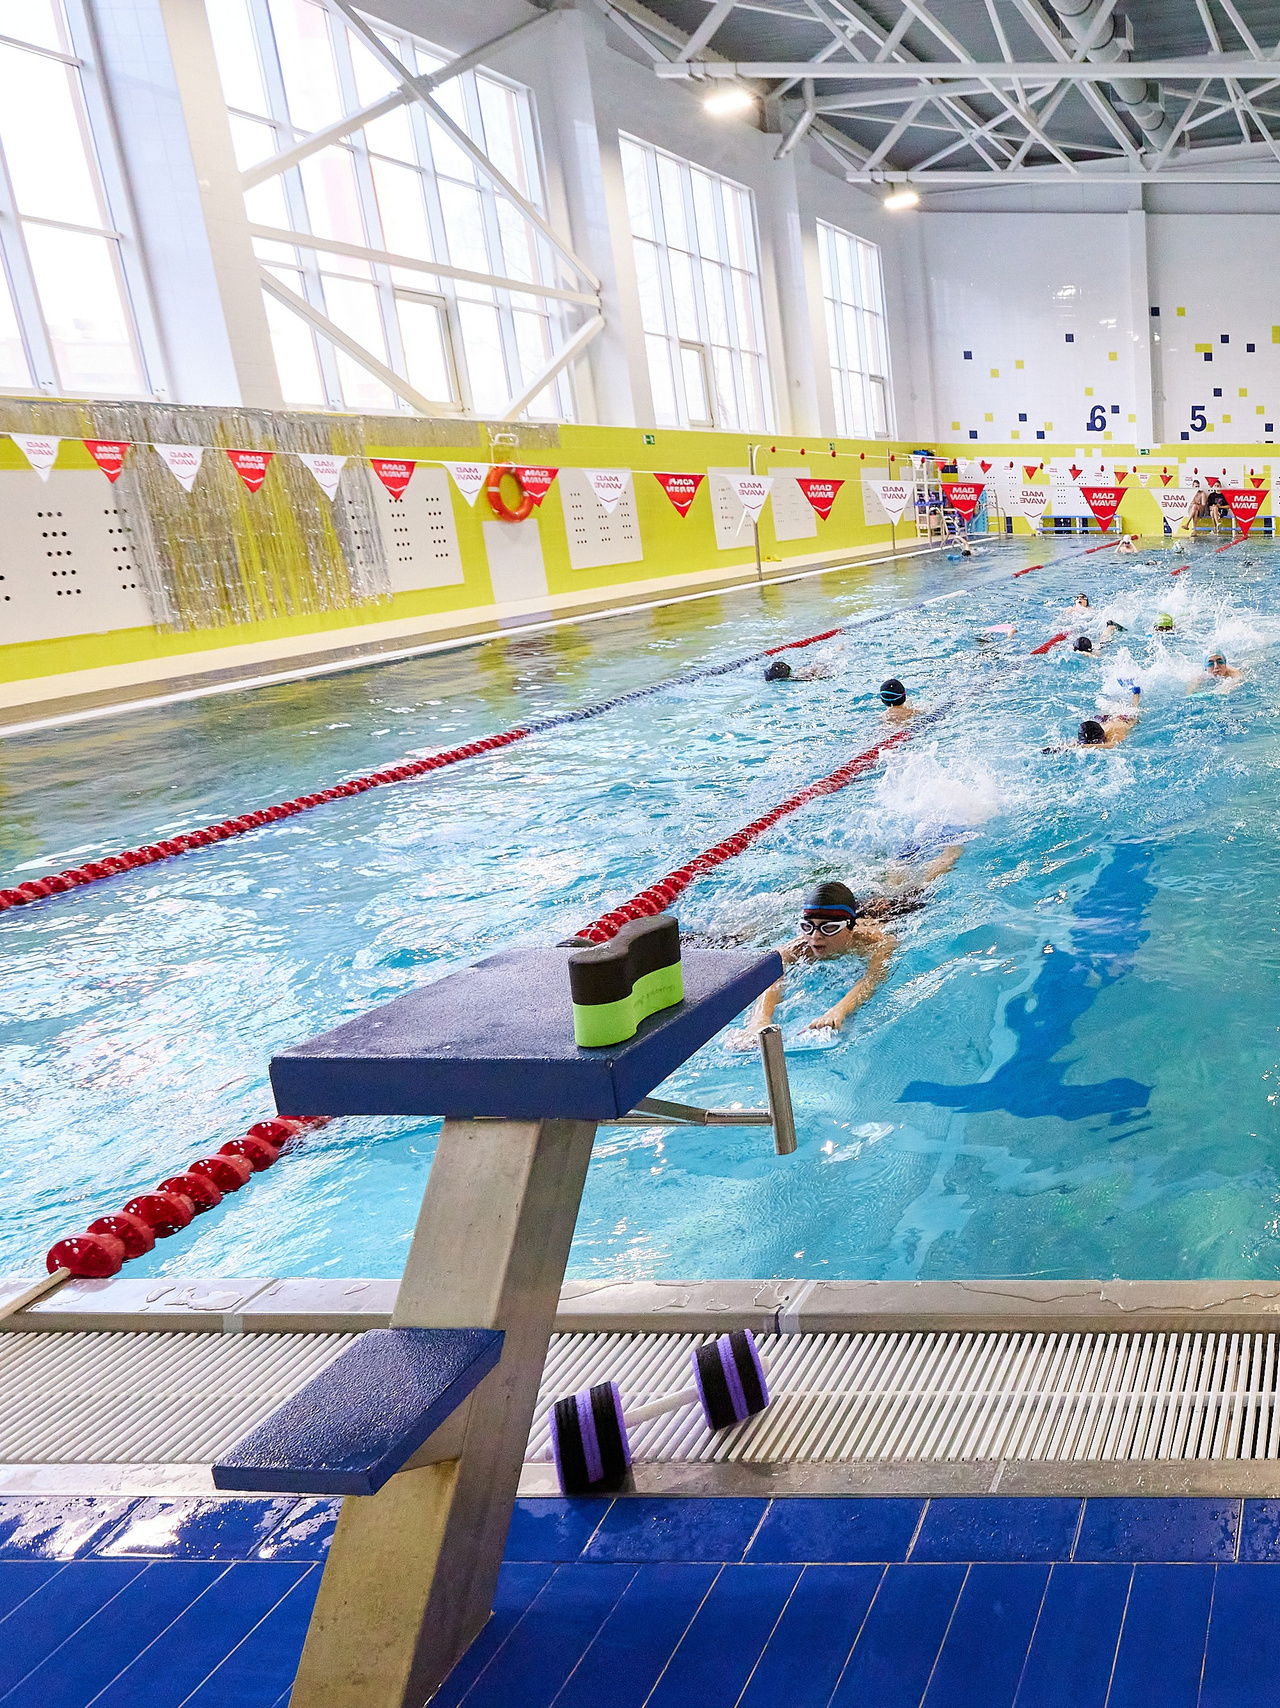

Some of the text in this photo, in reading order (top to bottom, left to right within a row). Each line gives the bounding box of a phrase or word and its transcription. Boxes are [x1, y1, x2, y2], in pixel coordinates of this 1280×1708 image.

[1089, 405, 1107, 432] 6
[1189, 405, 1207, 432] 5
[525, 469, 549, 477] MAD
[522, 476, 552, 484] WAVE
[807, 491, 834, 499] WAVE
[950, 493, 978, 501] WAVE
[1092, 492, 1115, 500] MAD
[1231, 502, 1259, 510] WAVE
